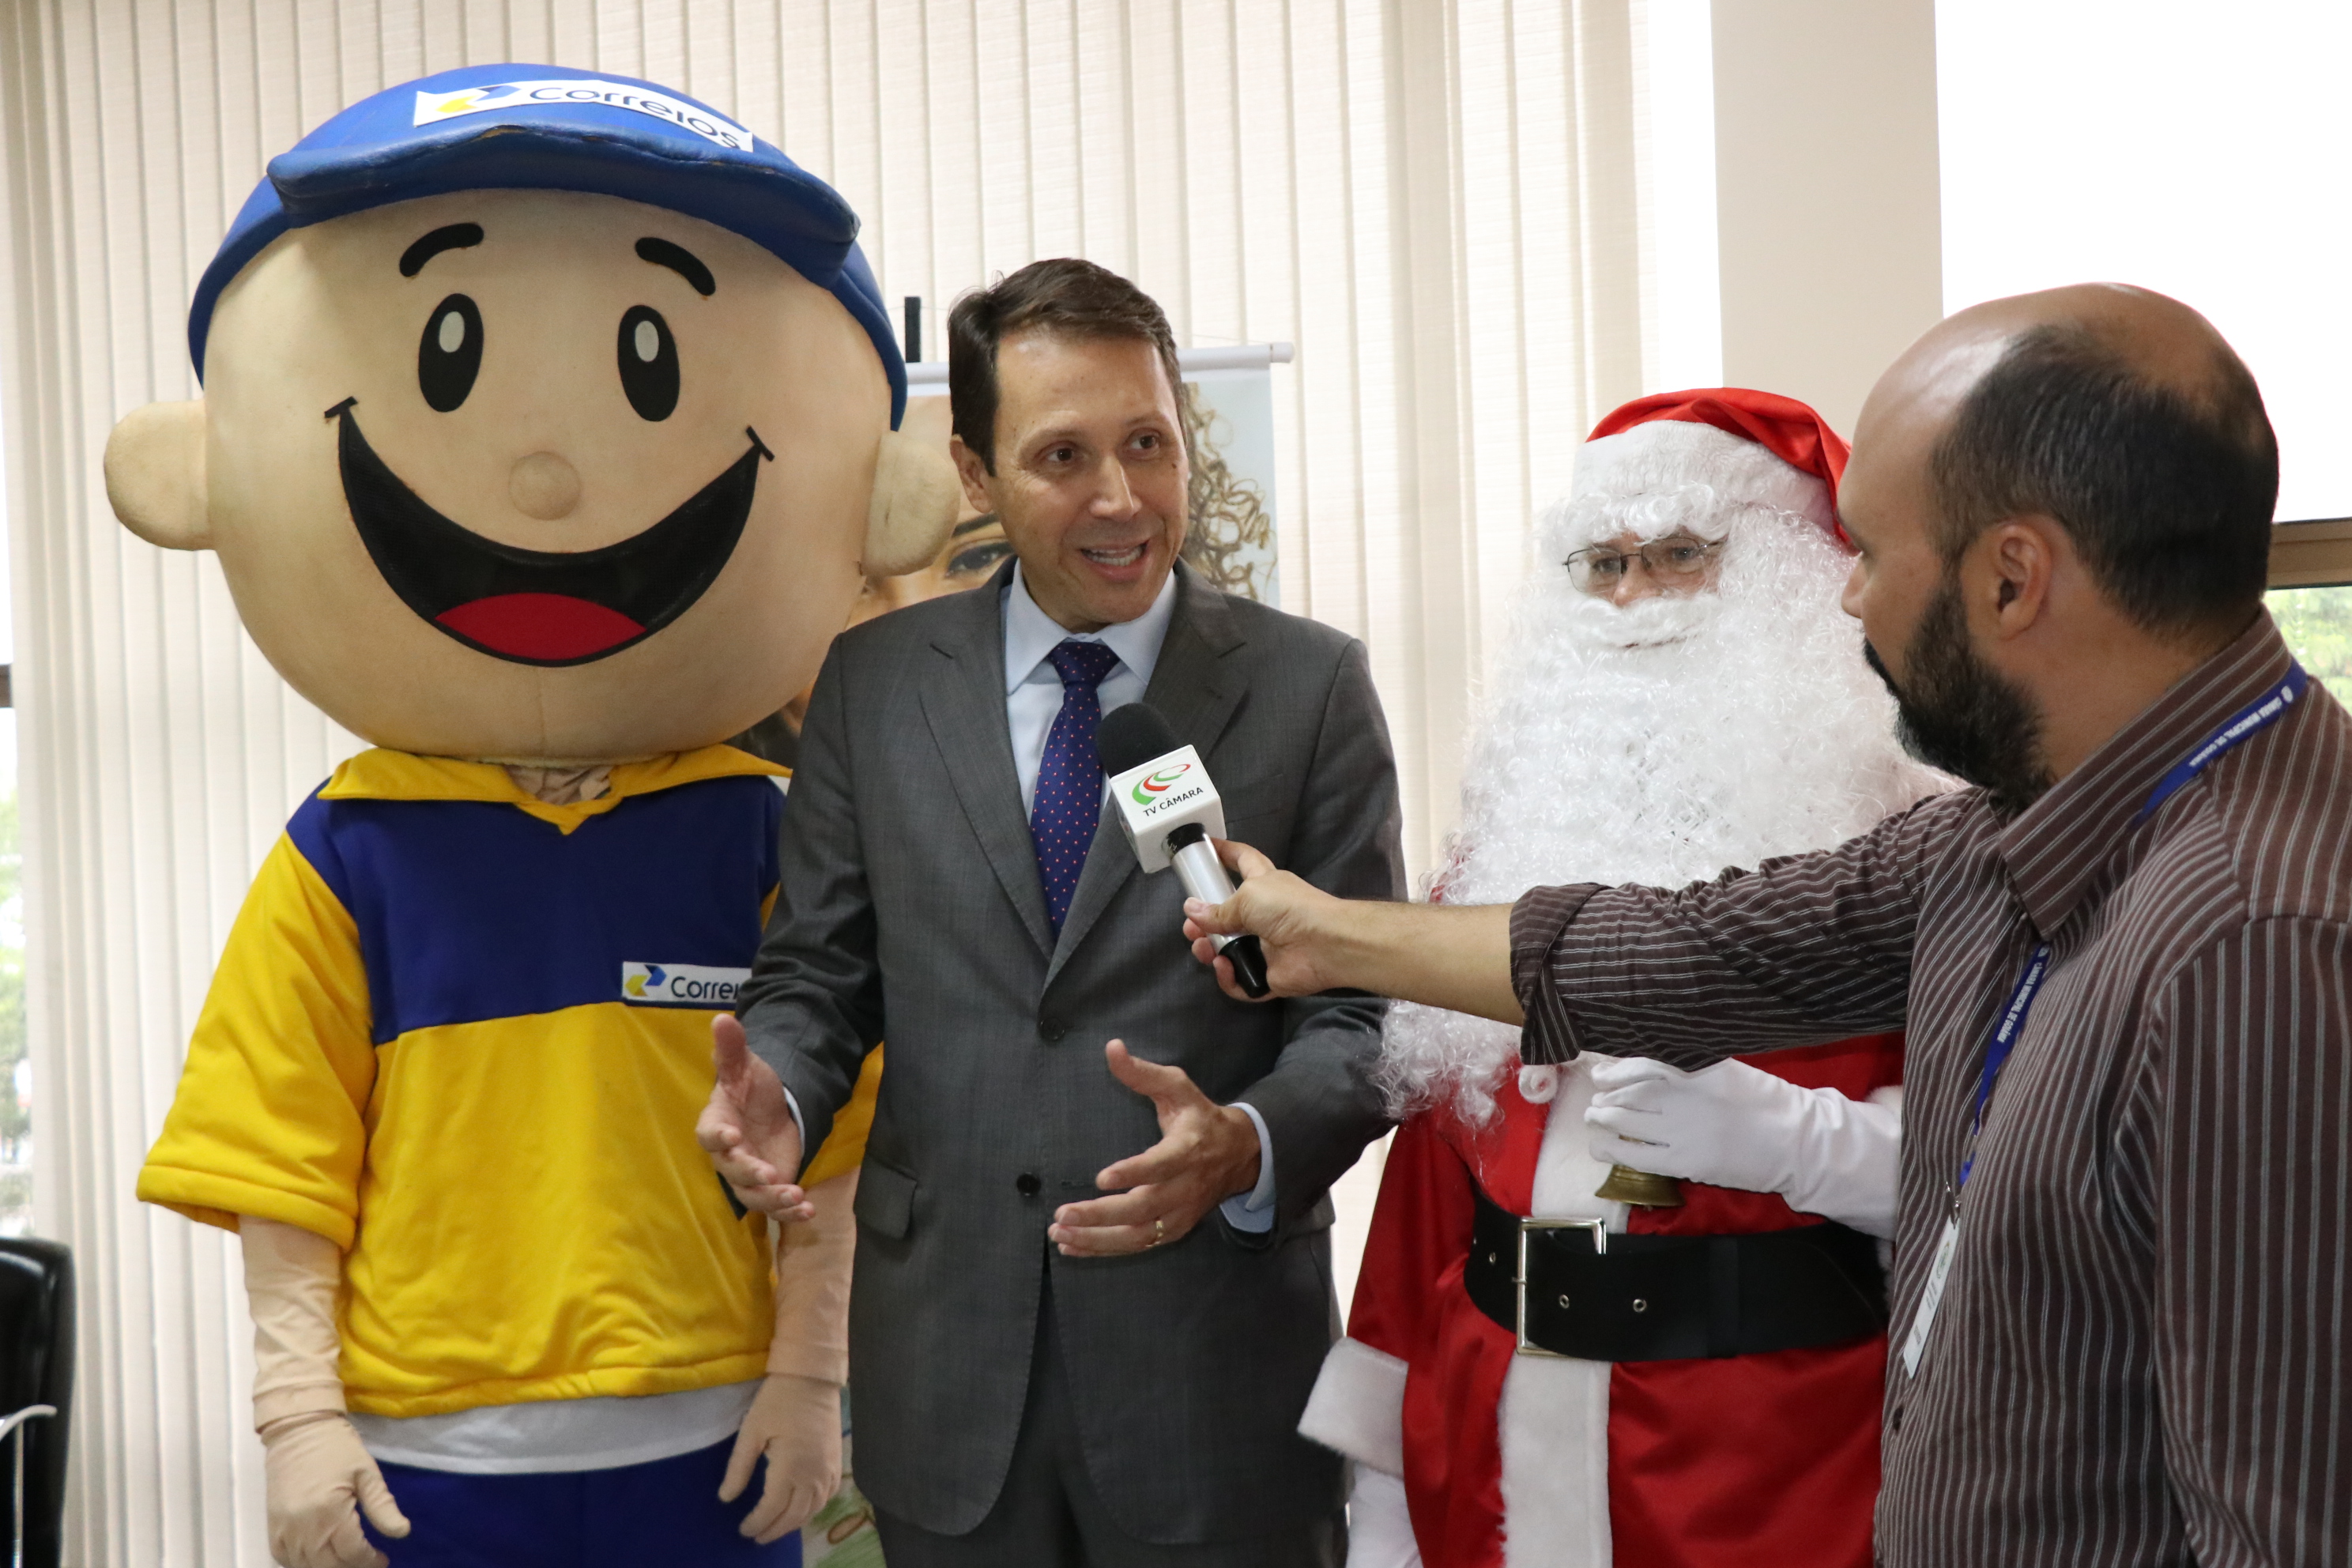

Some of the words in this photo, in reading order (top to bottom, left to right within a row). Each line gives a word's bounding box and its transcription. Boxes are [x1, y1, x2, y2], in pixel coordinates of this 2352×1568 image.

[530, 87, 741, 149] Correios
[1143, 806, 1156, 816] TV
[1159, 787, 1204, 810] CÂMARA
